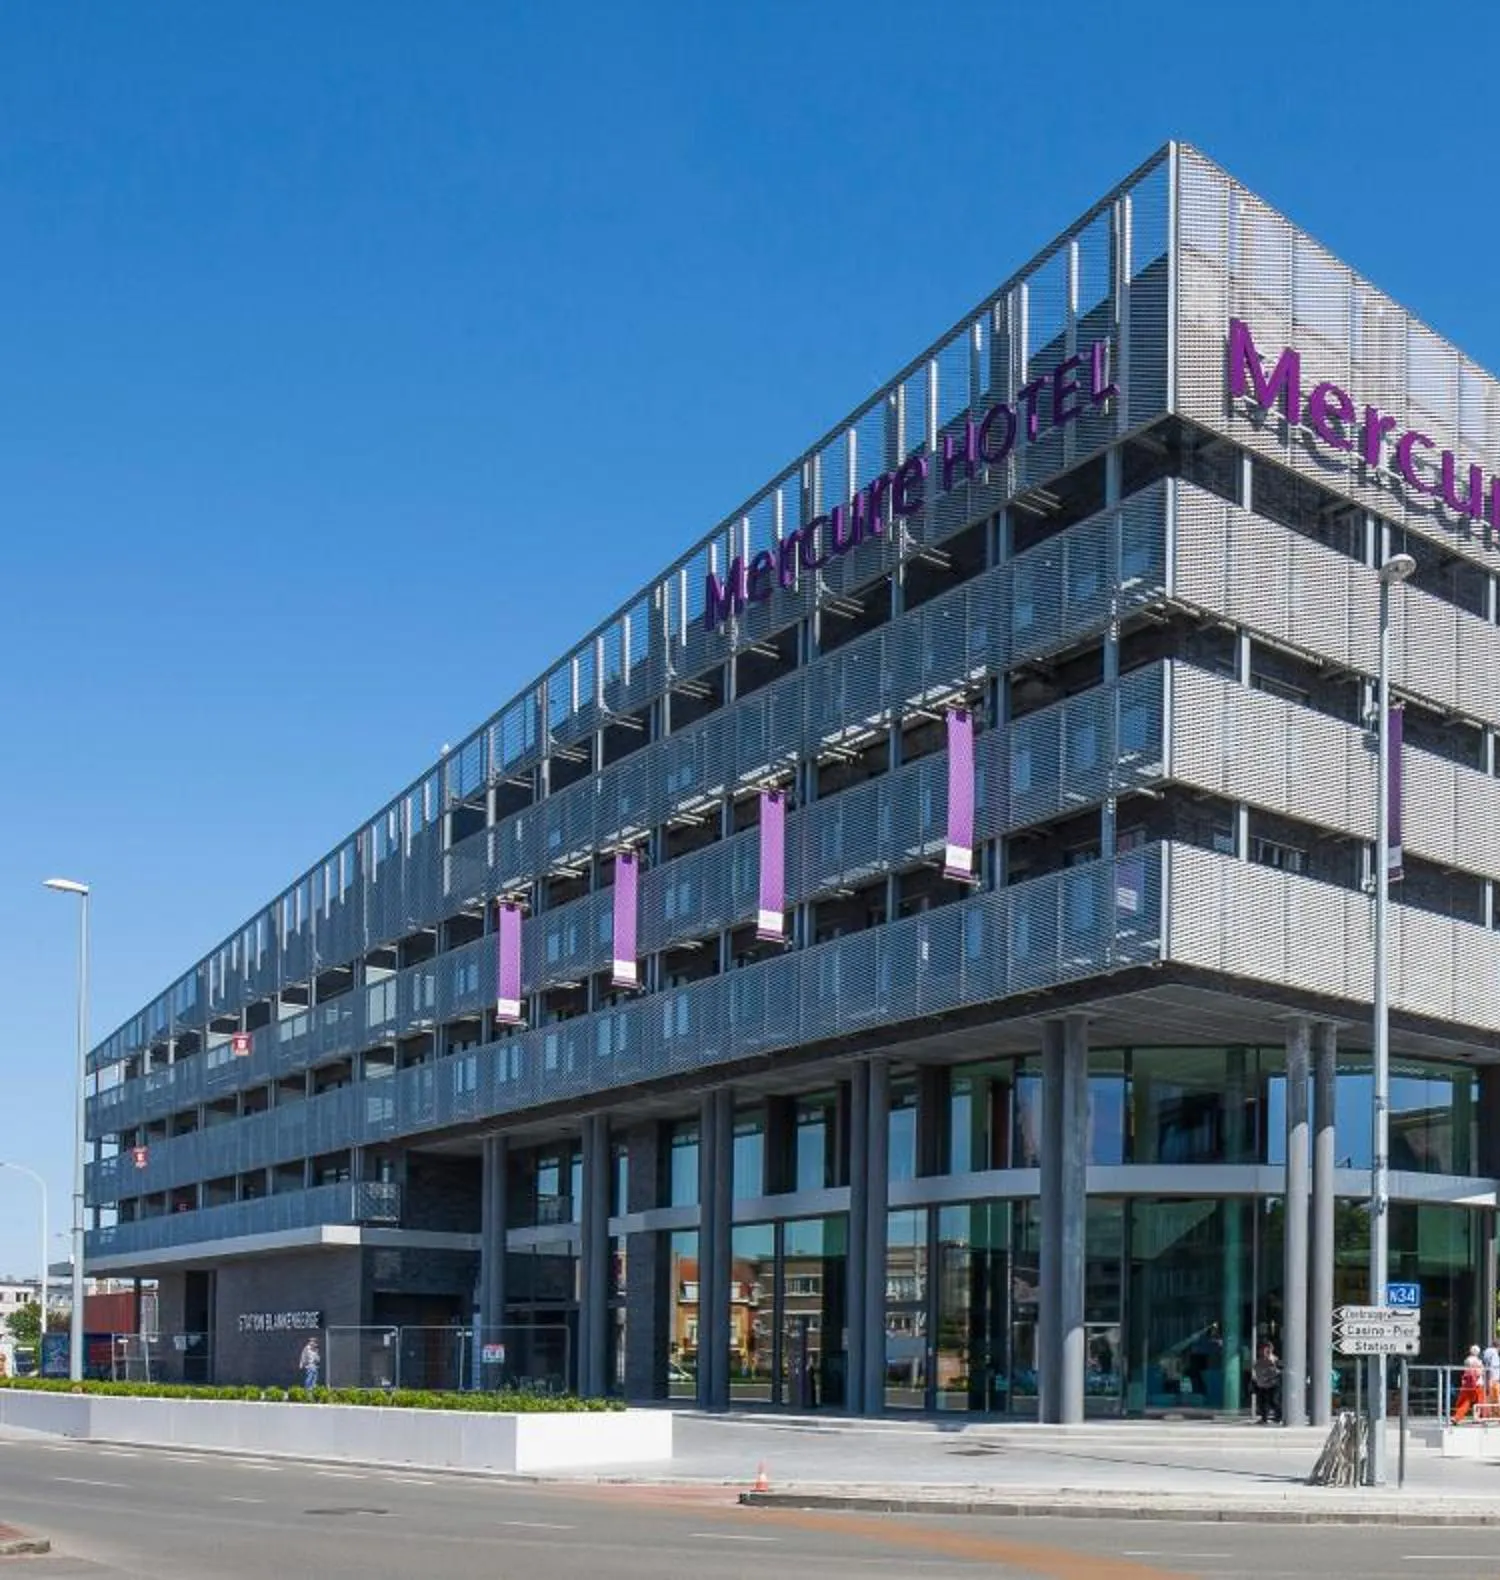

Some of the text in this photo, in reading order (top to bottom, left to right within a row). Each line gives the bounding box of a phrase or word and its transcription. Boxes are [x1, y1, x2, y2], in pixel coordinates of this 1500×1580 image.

[705, 340, 1120, 632] Mercure HOTEL
[1389, 1287, 1415, 1304] N34
[1347, 1325, 1385, 1336] Casino
[1355, 1341, 1397, 1352] Station
